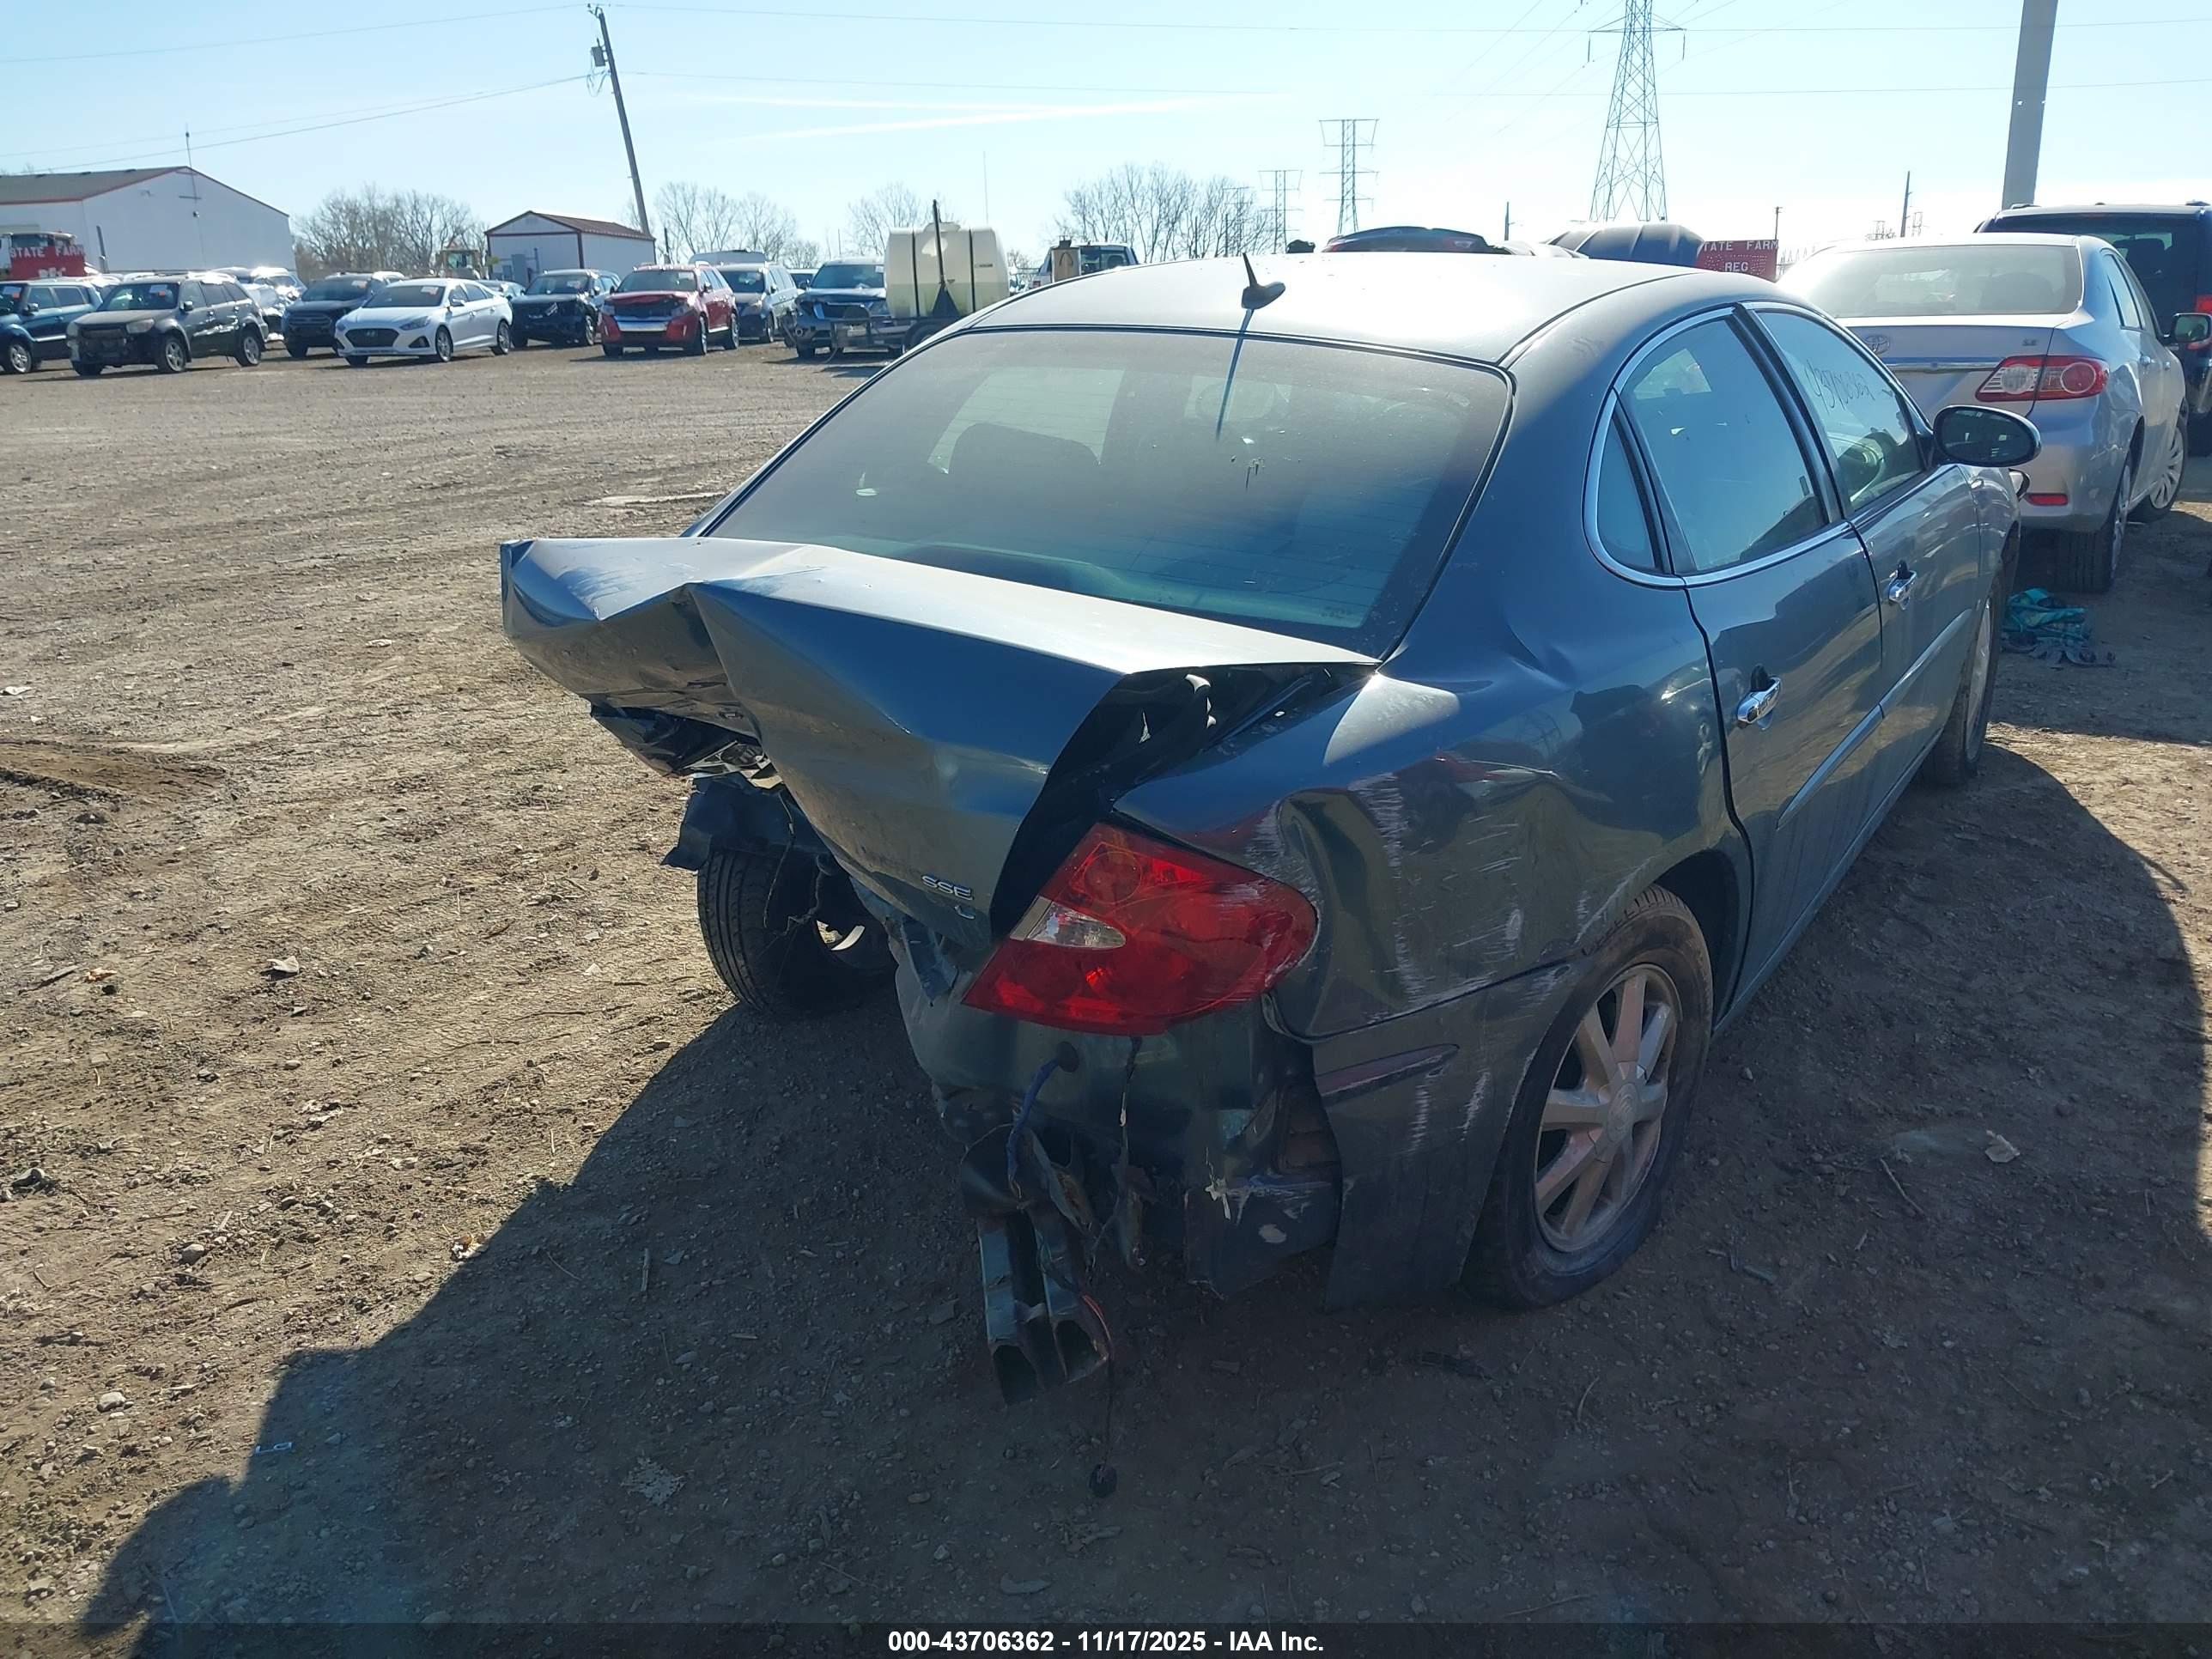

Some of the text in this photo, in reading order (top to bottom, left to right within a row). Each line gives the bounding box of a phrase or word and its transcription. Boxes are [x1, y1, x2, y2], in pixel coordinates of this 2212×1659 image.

[1704, 240, 1778, 251] TATE FARM
[10, 247, 45, 258] STATE
[921, 875, 973, 900] SSE
